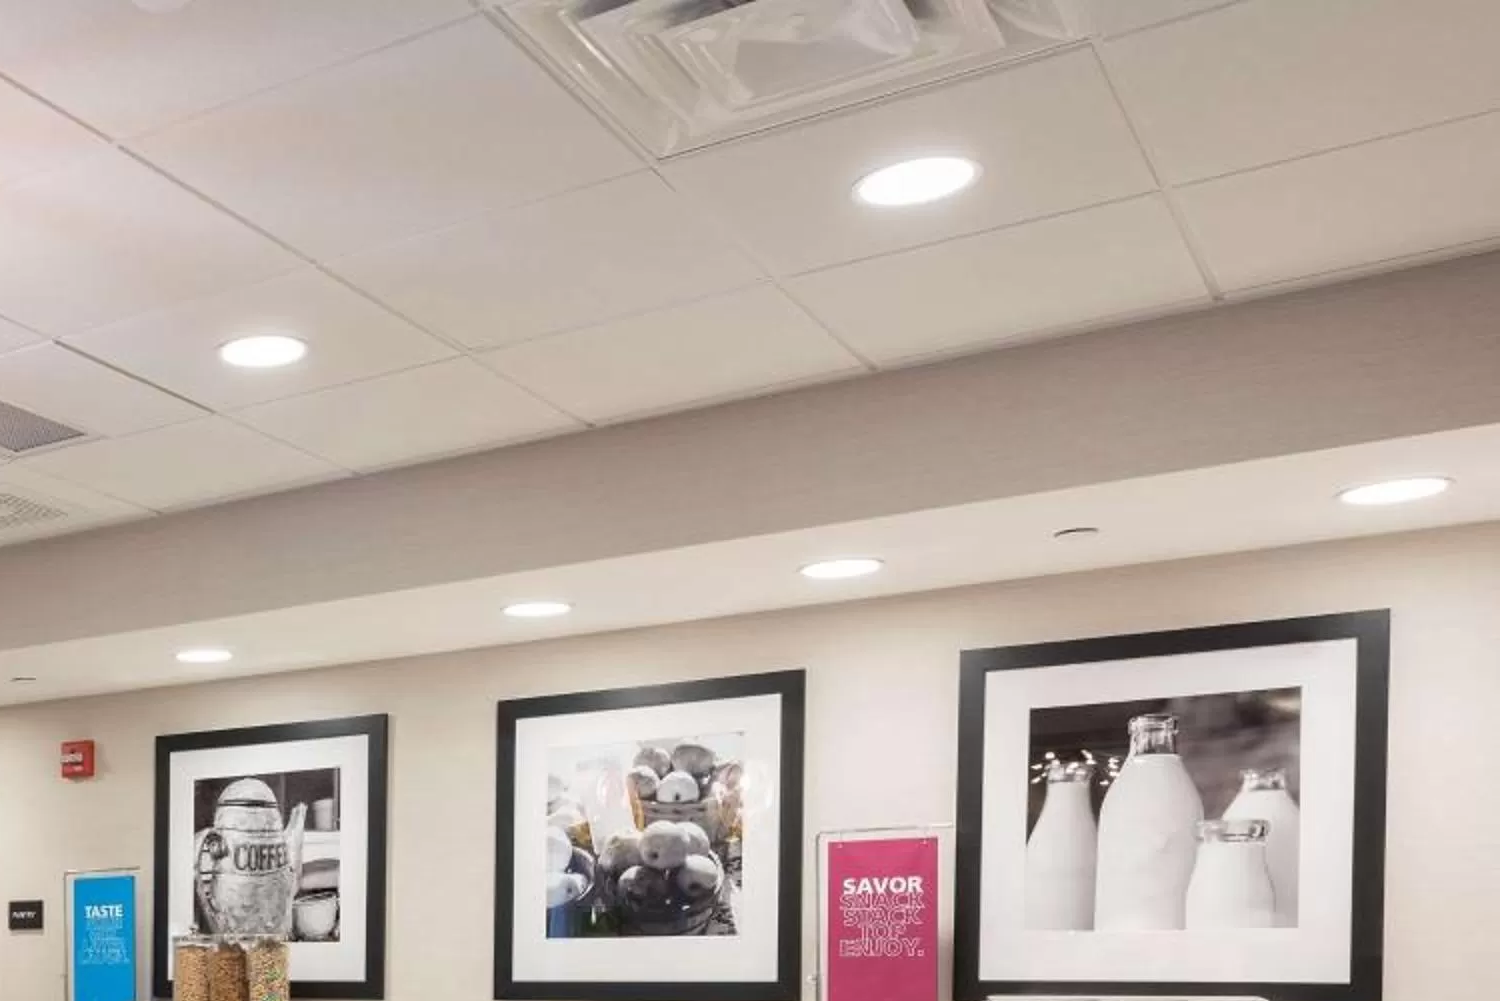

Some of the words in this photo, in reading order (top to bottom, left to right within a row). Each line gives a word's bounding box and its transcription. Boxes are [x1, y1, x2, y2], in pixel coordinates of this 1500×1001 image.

[843, 876, 924, 895] SAVOR
[840, 891, 925, 911] SNACK
[84, 904, 124, 919] TASTE
[843, 906, 923, 928] STACK
[840, 937, 925, 957] ENJOY.
